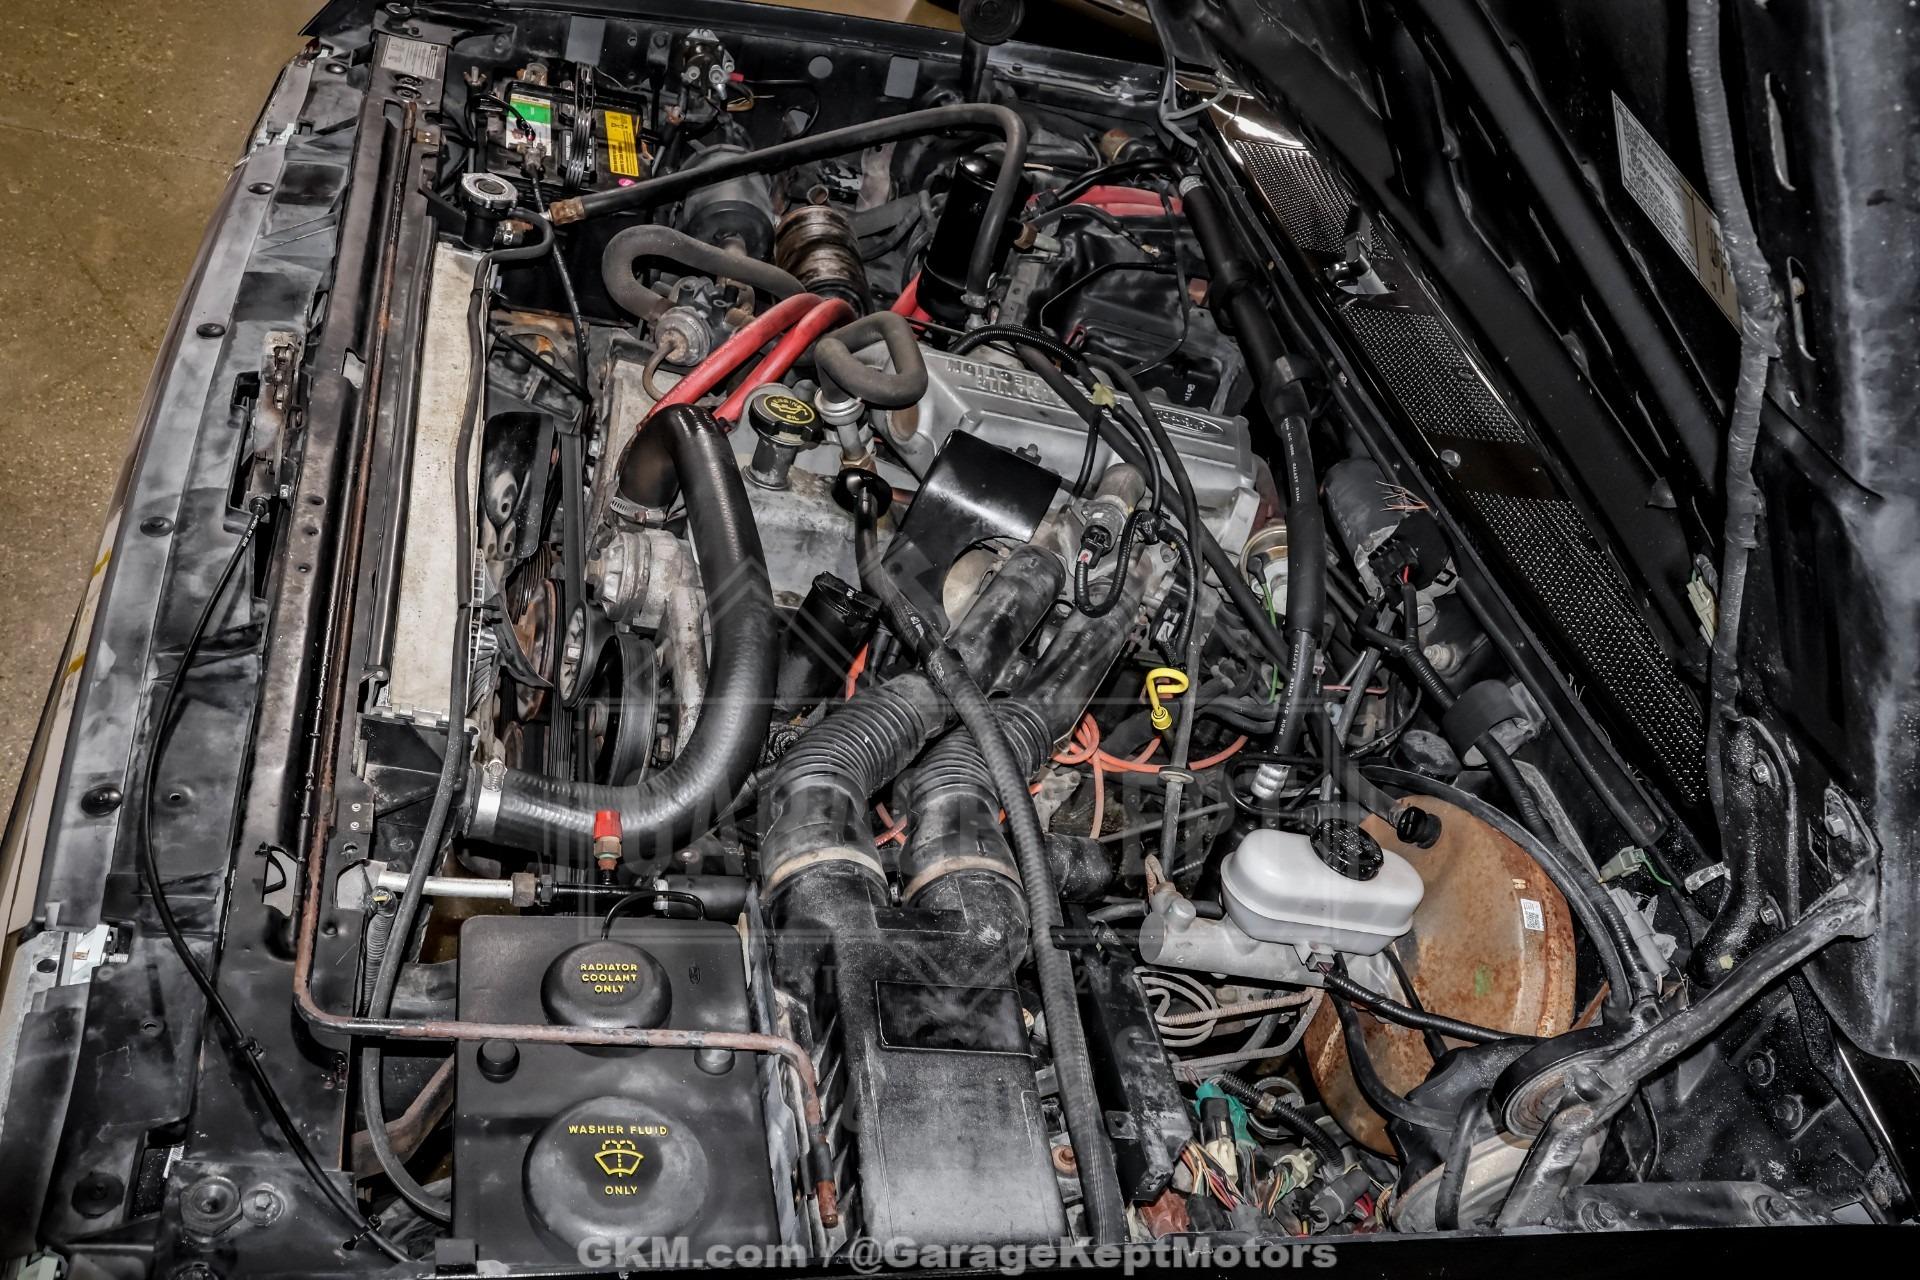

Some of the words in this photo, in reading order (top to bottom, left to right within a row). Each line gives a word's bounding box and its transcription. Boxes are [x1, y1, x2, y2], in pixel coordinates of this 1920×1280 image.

[1292, 644, 1300, 671] GALAXY
[579, 963, 638, 972] RADIATOR
[581, 973, 637, 982] COOLANT
[594, 984, 625, 993] ONLY
[568, 1125, 624, 1135] WASHER
[629, 1125, 669, 1137] FLUID
[604, 1185, 638, 1195] ONLY
